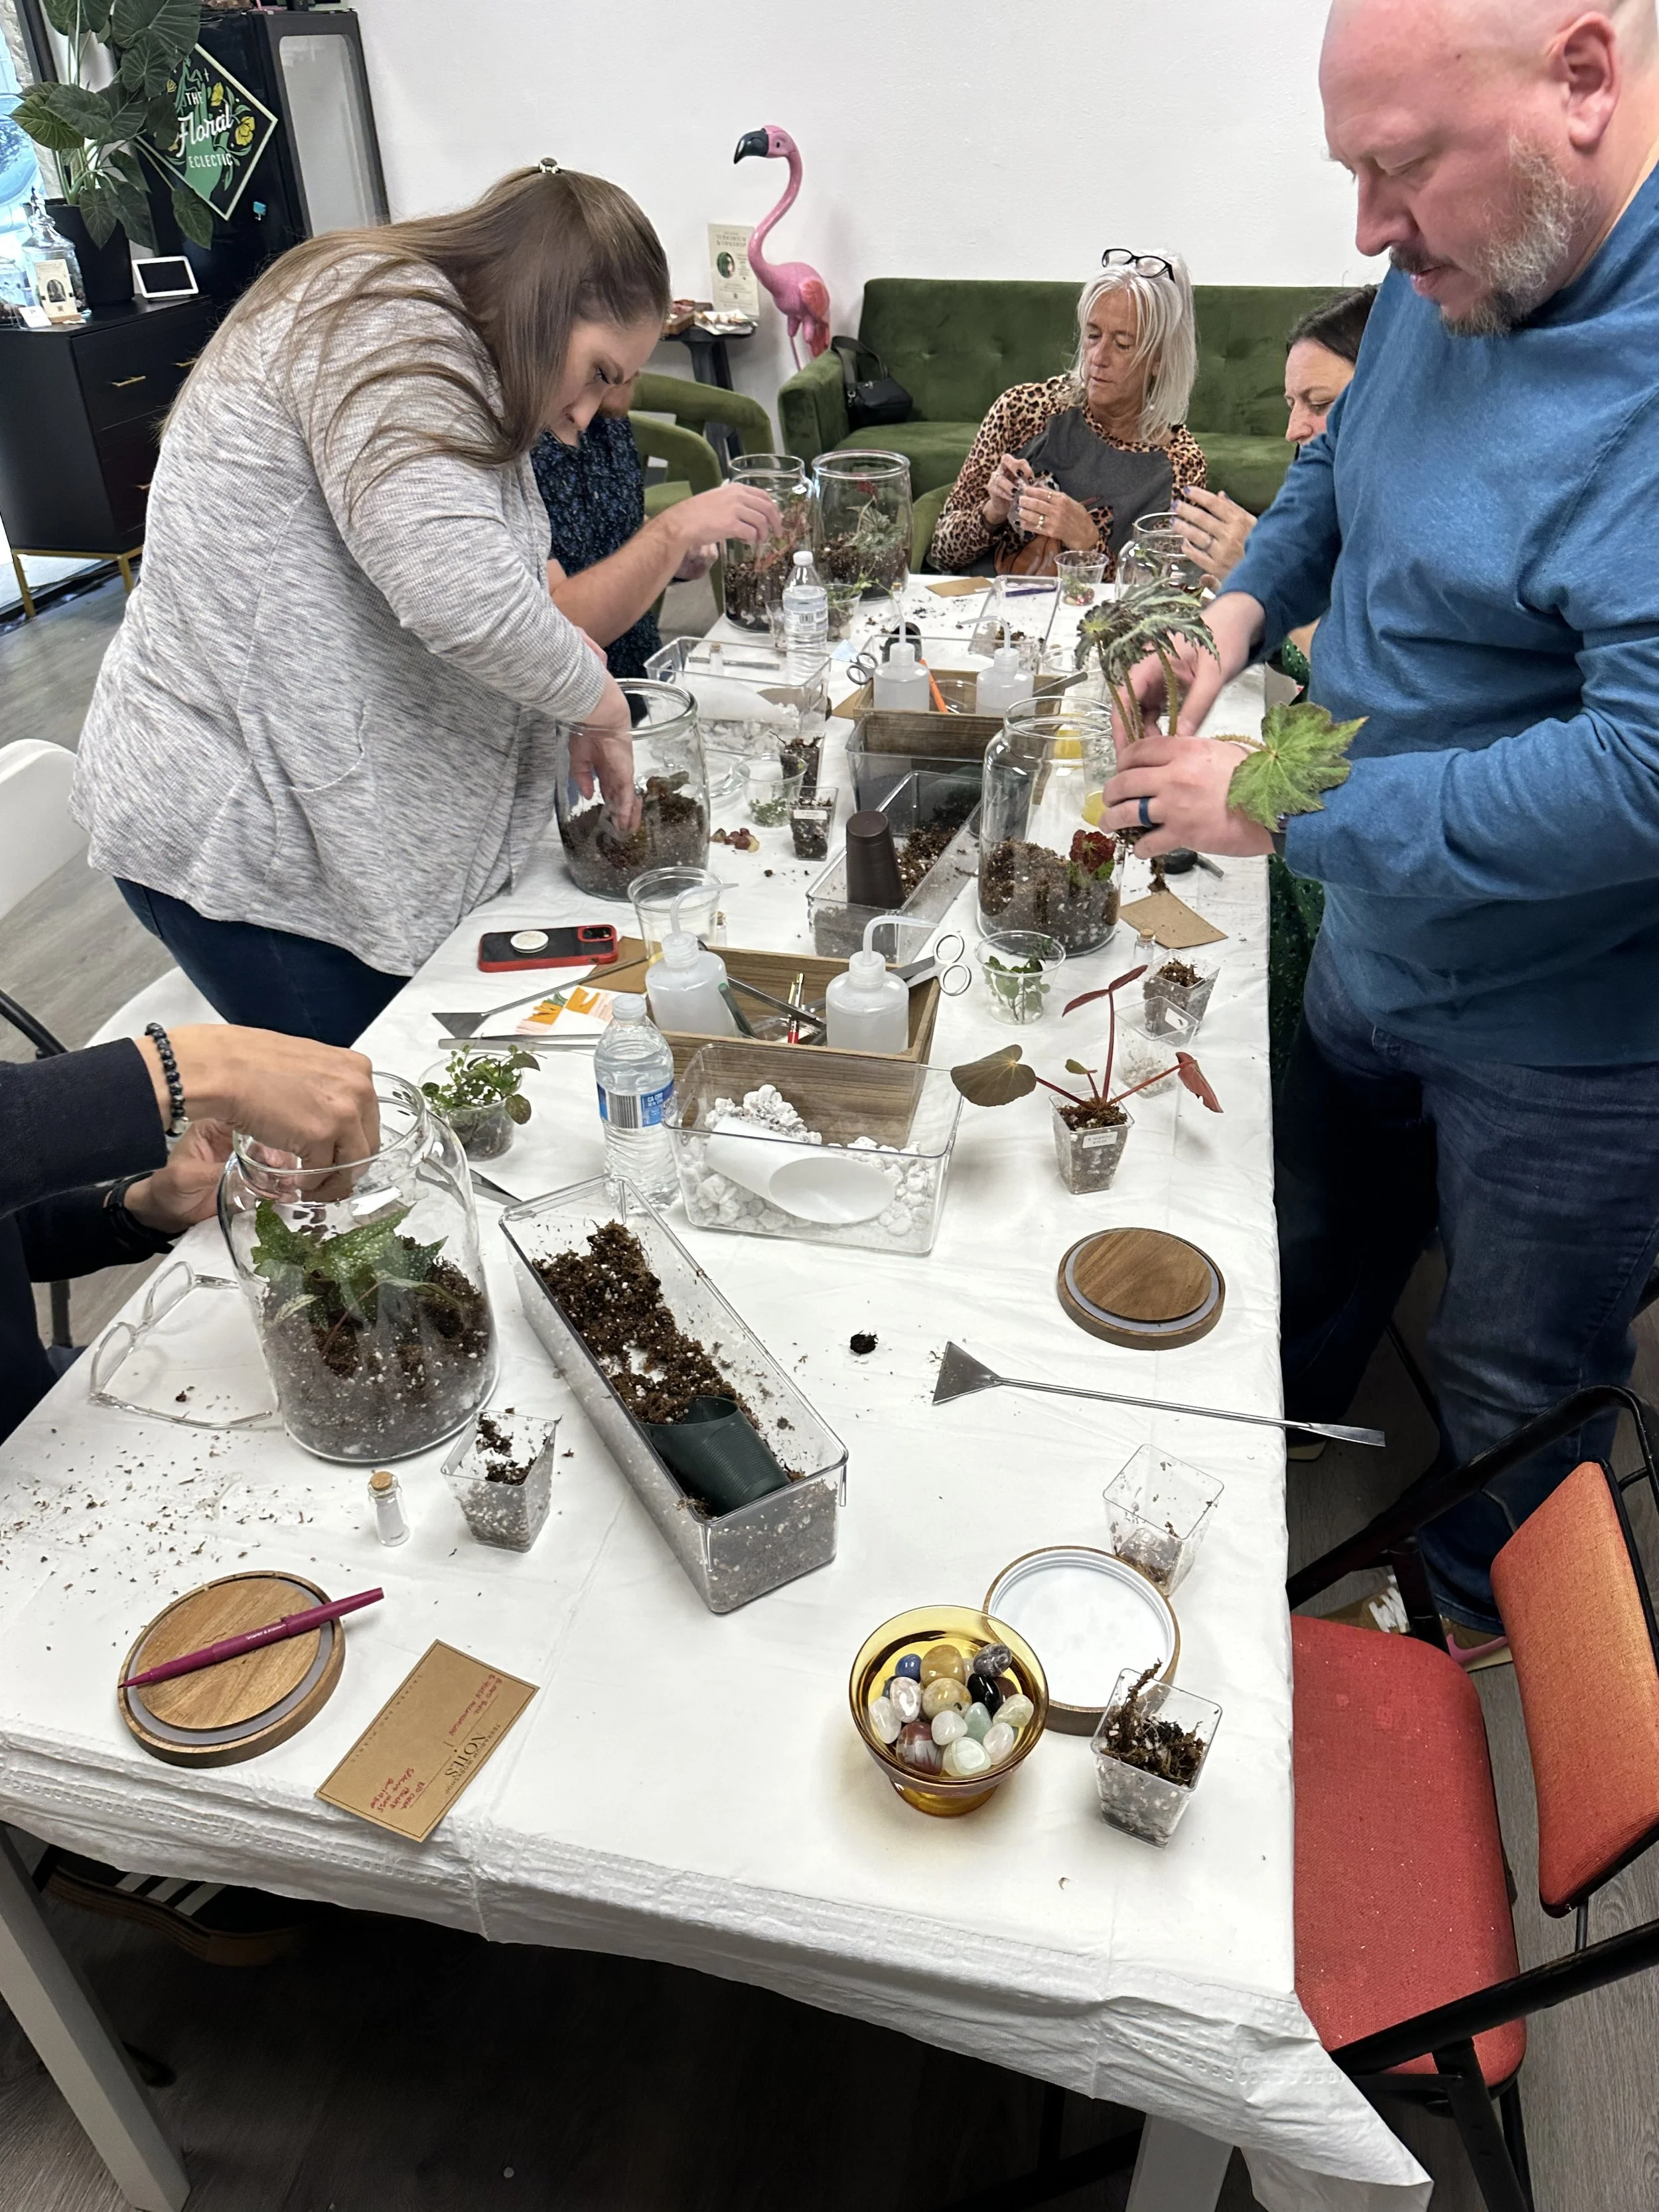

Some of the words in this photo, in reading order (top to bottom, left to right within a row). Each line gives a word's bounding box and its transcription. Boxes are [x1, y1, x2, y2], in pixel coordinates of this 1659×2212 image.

[185, 92, 204, 106] THE
[176, 104, 234, 157] Floral
[188, 153, 233, 168] ECLECTIC
[444, 1732, 486, 1779] NOTES
[472, 1724, 500, 1758] TERRARIUM
[443, 1759, 473, 1795] WORKSHOP
